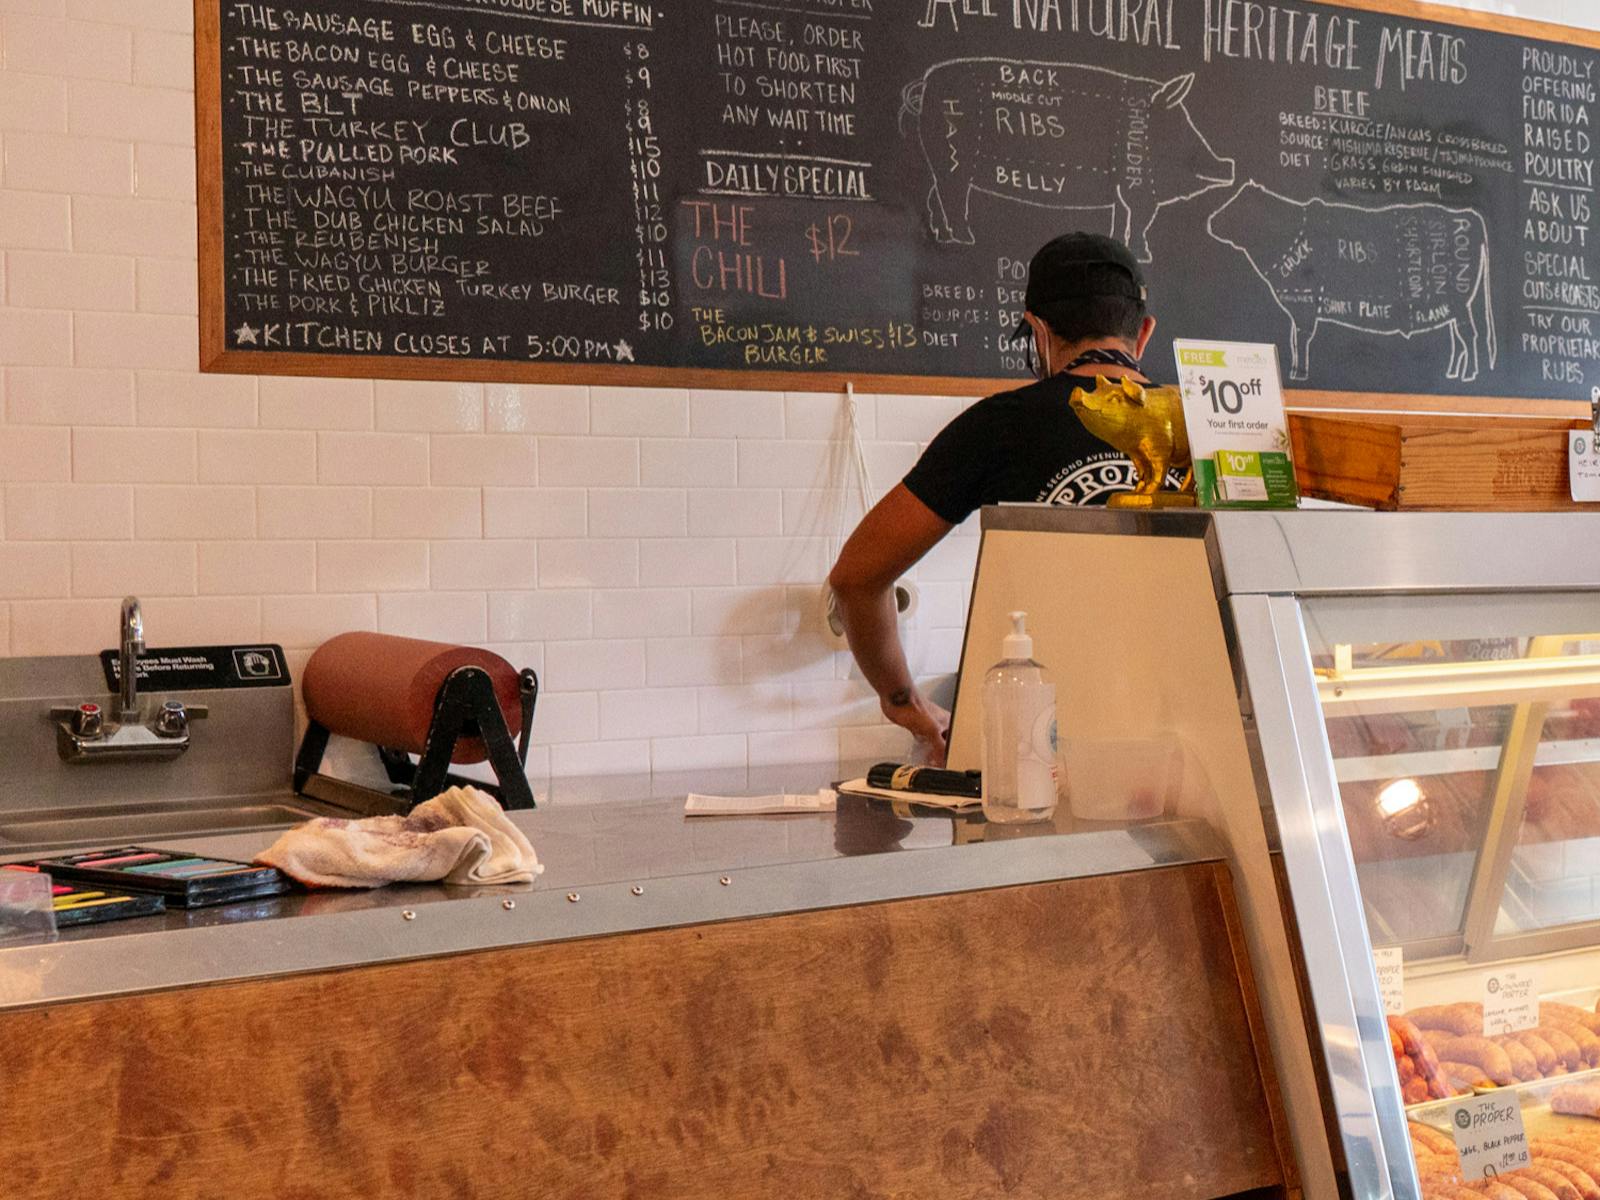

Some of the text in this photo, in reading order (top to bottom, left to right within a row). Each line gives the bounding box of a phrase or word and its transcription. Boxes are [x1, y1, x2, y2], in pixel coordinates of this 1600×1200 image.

[583, 0, 652, 26] MUFFIN
[235, 3, 568, 60] THE SAUSAGE EGG CHEESE
[803, 23, 864, 51] ORDER
[1203, 0, 1361, 71] HERITAGE
[1375, 27, 1468, 92] MEATS
[236, 36, 519, 83] THE BACON EGG CHEESE
[717, 44, 861, 79] HOT FOOD FIRST
[1522, 47, 1594, 79] PROUDLY
[719, 73, 855, 104] TO SHORTEN
[1000, 64, 1060, 87] BACK
[1522, 76, 1596, 103] OFFERING
[236, 66, 571, 115] THE SAUSAGE PEPPERS ONION
[236, 90, 363, 115] THE BLT
[992, 90, 1063, 106] MIDDLE CUT
[1314, 85, 1370, 117] BEEF
[722, 104, 856, 136] ANY WAIT TIME
[995, 107, 1065, 138] RIBS
[1523, 95, 1589, 126] FLORIDA
[243, 114, 296, 139] THE
[302, 118, 430, 144] TURKEY
[450, 118, 530, 149] CLUB
[944, 99, 964, 173] HAM
[1125, 97, 1148, 190] SHOULDER
[1524, 122, 1590, 154] RAISED
[240, 140, 291, 159] THE
[300, 139, 393, 164] PULLED
[399, 145, 459, 165] PORK
[1280, 152, 1311, 167] DIET
[241, 161, 395, 182] THE CUBANISH
[996, 166, 1066, 193] BELLY
[1525, 151, 1594, 186] POULTRY
[246, 183, 563, 220] THE WAGYU ROAST BEEF
[1529, 187, 1591, 223] ASK US
[244, 208, 544, 236] THE DUB CHICKEN SALAD
[681, 200, 860, 264] THE $12
[1524, 218, 1589, 247] ABOUT
[244, 230, 438, 254] THE REUBENISH
[1338, 238, 1378, 263] RIBS
[1452, 217, 1471, 293] ROUND
[244, 248, 491, 278] THE WAGYU BURGER
[692, 245, 787, 300] CHILI
[1524, 251, 1590, 280] SPECIAL
[238, 267, 278, 288] THE
[289, 268, 350, 292] FRIED
[358, 273, 441, 297] CHICKEN
[456, 279, 532, 300] TURKEY
[543, 282, 620, 305] BURGER
[238, 294, 674, 331] THE PORK PIKLIZ $10
[692, 307, 726, 325] THE
[1359, 301, 1392, 319] PLATE
[1528, 313, 1592, 336] TRY OUR
[263, 322, 382, 351] KITCHEN
[394, 332, 471, 356] CLOSES
[482, 335, 511, 353] AT
[701, 323, 759, 346] BACON
[761, 322, 802, 344] JAM
[824, 328, 885, 349] SWISS
[923, 331, 958, 347] DIET
[745, 344, 829, 366] BURGER
[1184, 351, 1213, 363] FREE
[1542, 358, 1584, 385] RUBS
[1207, 419, 1268, 430] Your first order
[1047, 452, 1125, 488] SECOND AVENUE
[172, 663, 214, 671] Returning
[1473, 1106, 1514, 1128] PROPER
[1478, 1102, 1495, 1112] THE
